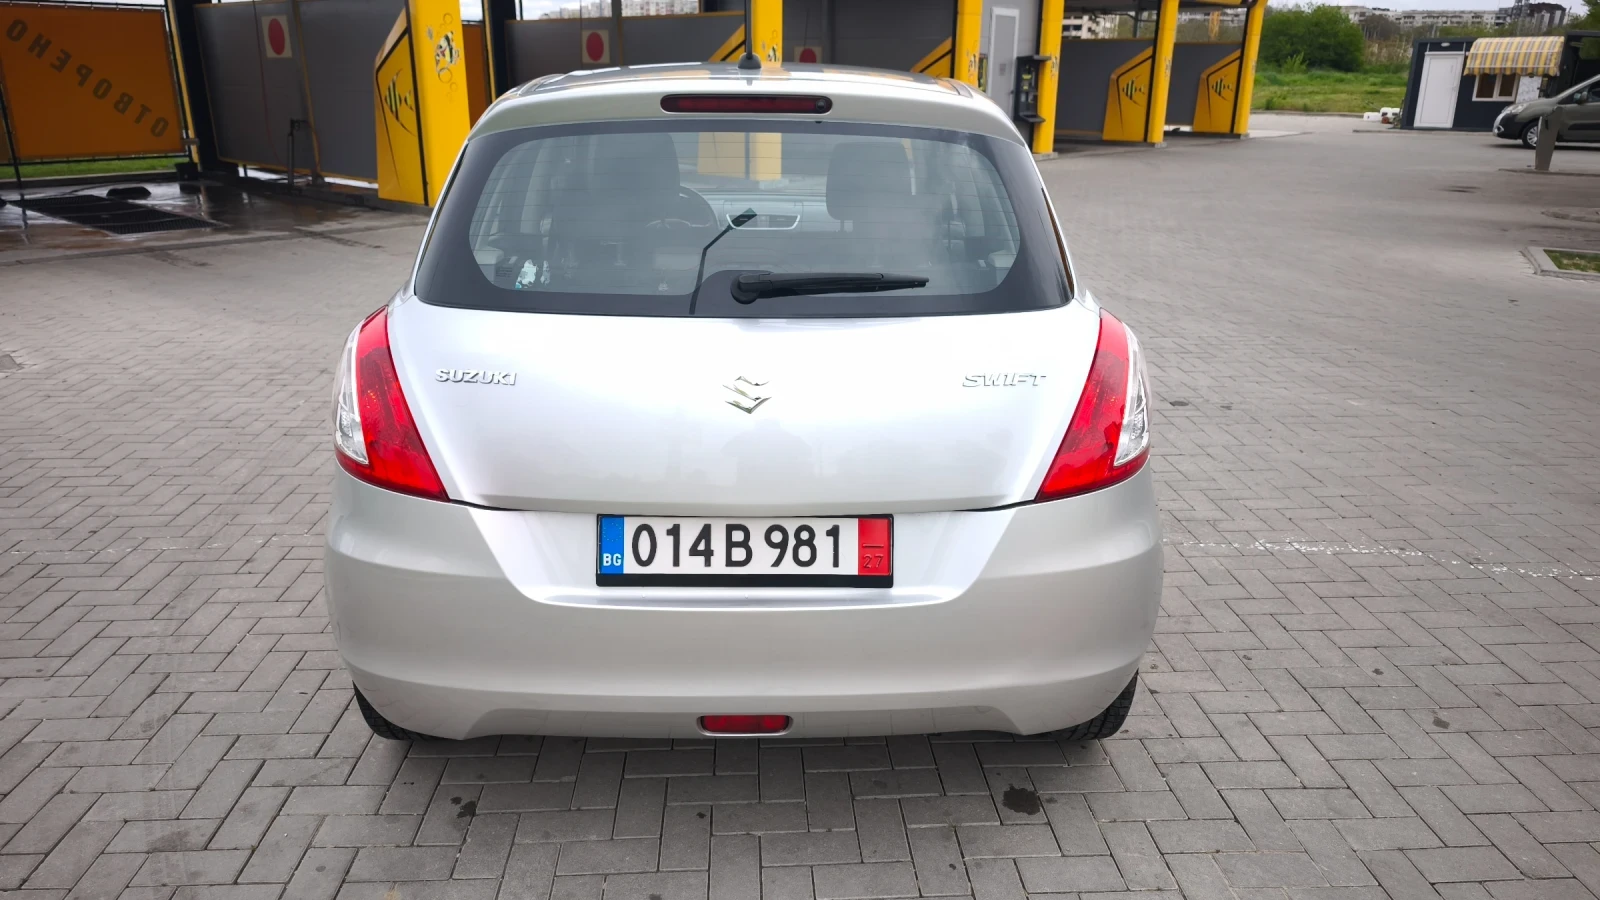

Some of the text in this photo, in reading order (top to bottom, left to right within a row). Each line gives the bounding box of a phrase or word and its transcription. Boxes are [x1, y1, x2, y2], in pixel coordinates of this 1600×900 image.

[435, 368, 517, 386] SUZUKI
[962, 372, 1047, 387] SWIFT
[603, 553, 622, 567] BG
[863, 553, 884, 569] 27
